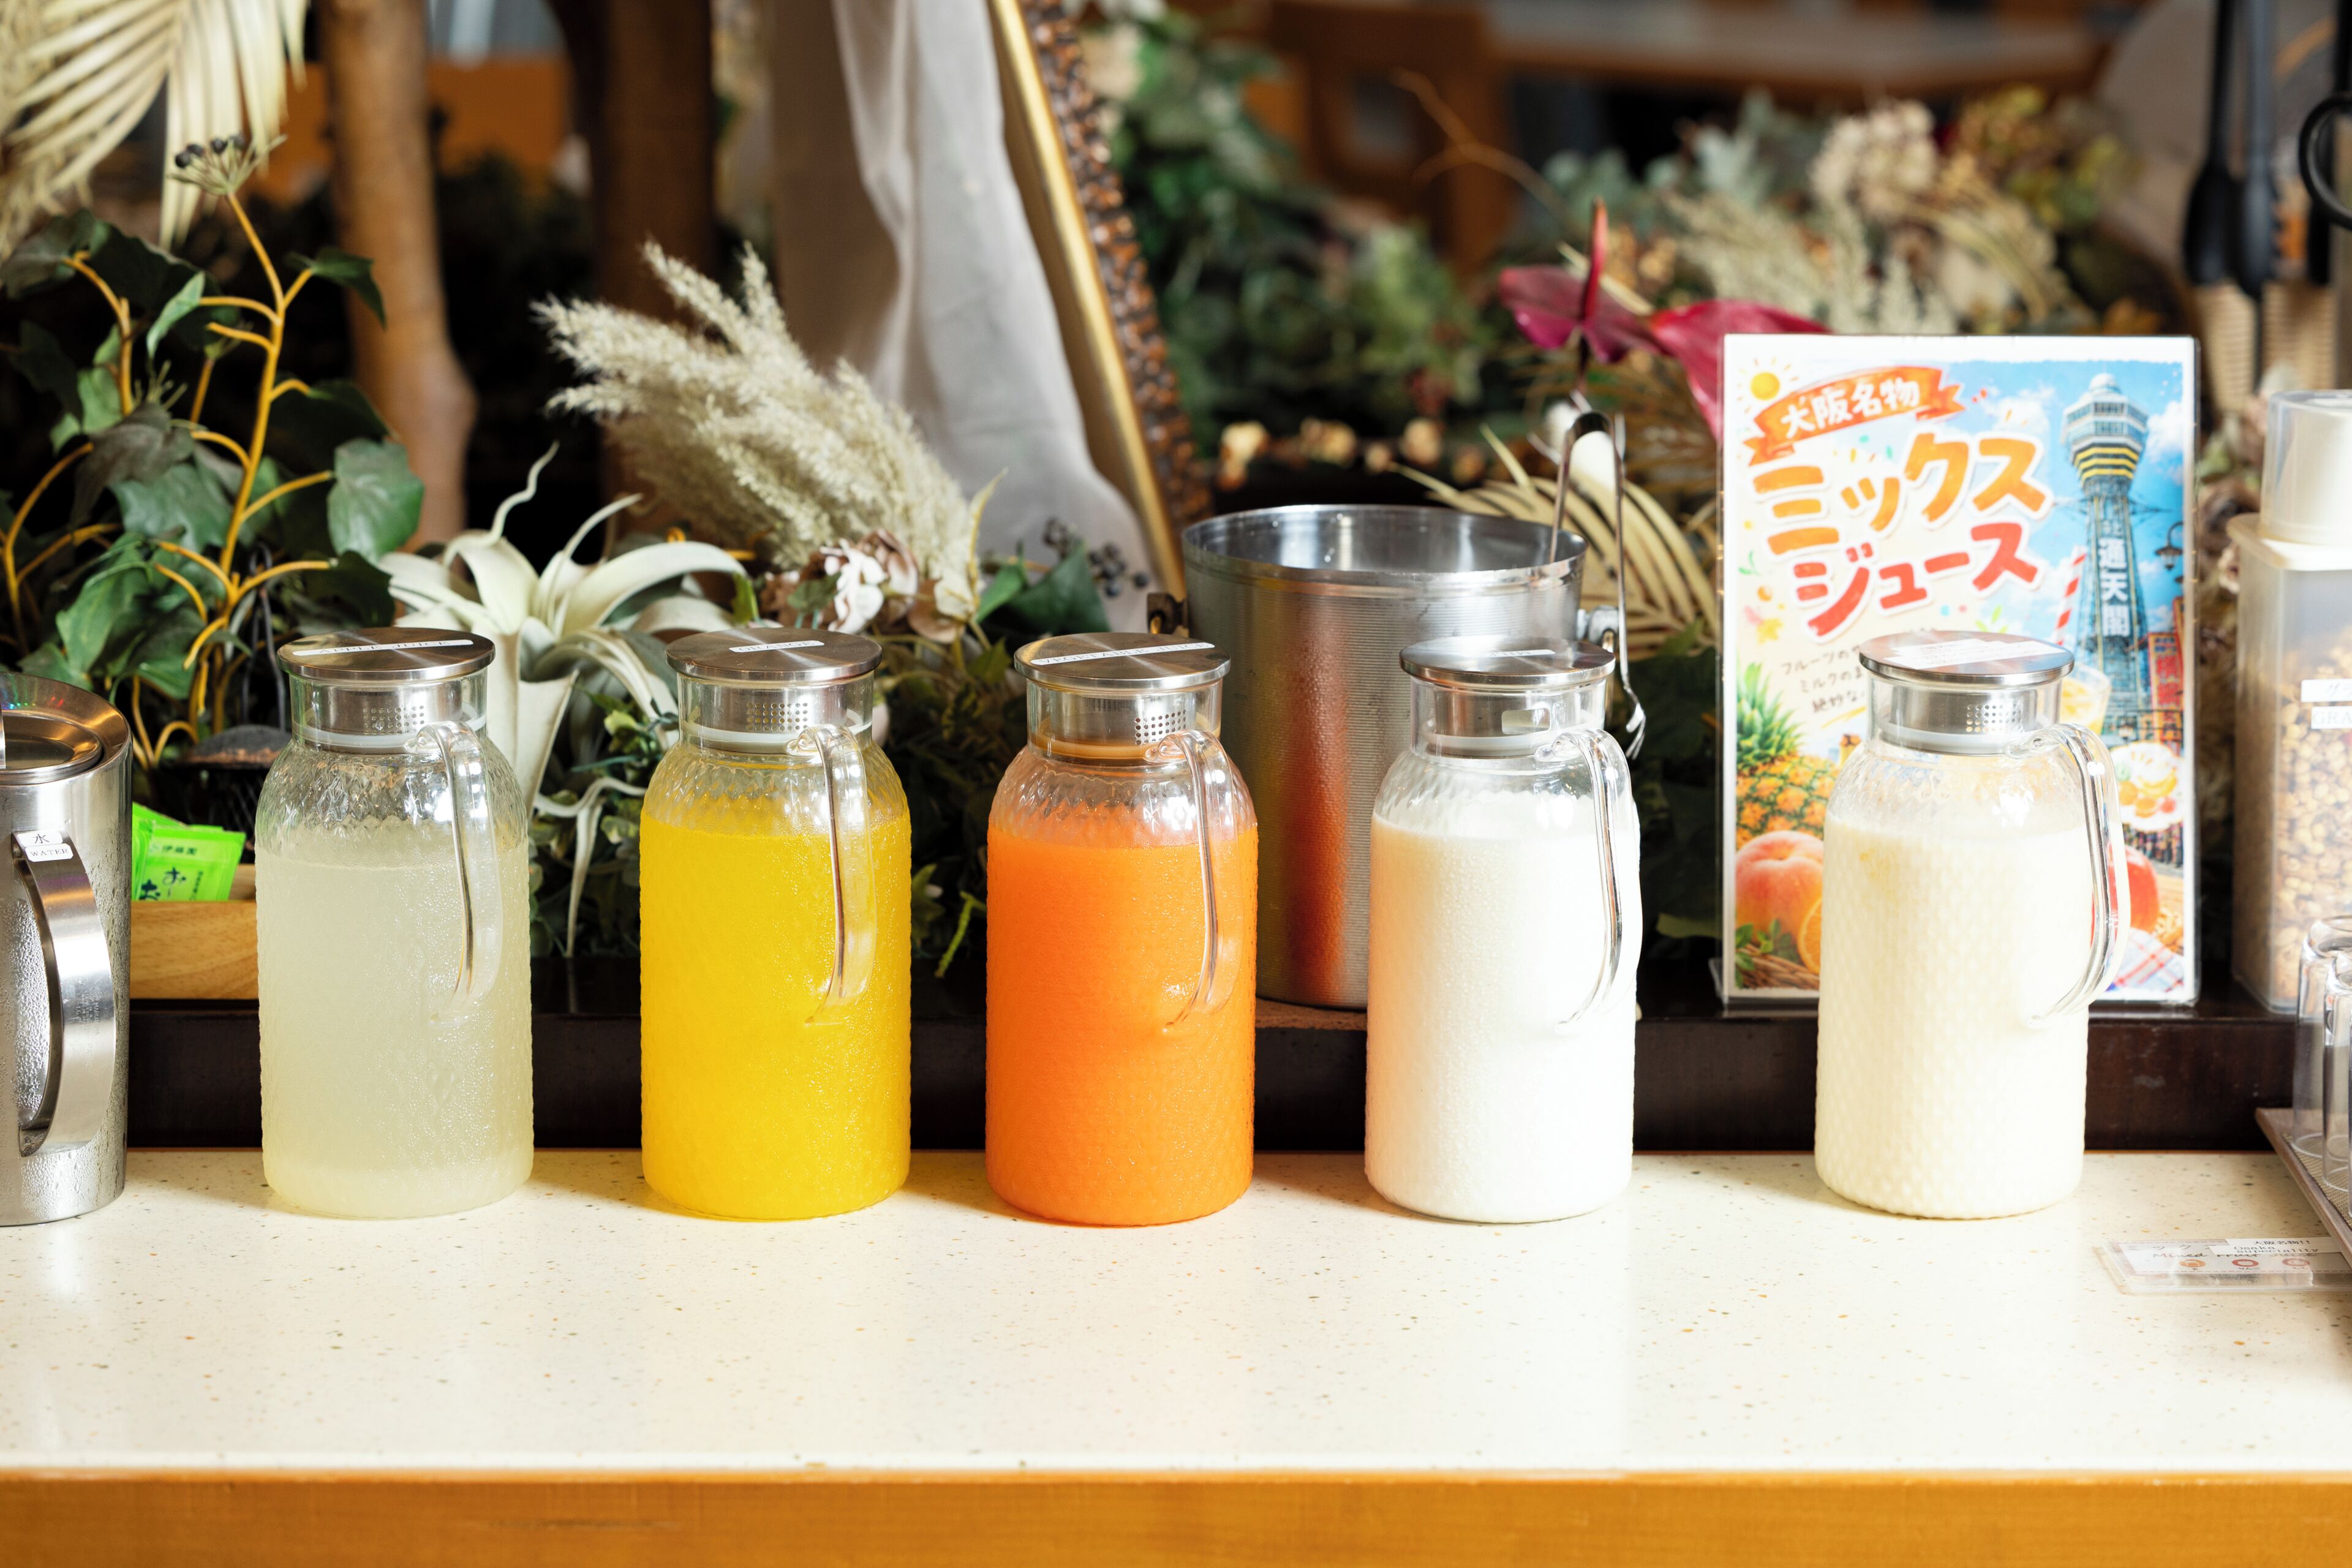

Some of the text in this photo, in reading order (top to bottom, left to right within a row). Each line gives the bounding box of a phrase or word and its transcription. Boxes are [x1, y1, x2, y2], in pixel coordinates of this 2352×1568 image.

[1781, 376, 1921, 439] 大阪名物
[1752, 432, 2047, 556] ミックス
[1792, 521, 2038, 638] ジュース
[319, 645, 382, 654] APPLE
[739, 641, 815, 652] ORANGE
[1039, 643, 1212, 663] VEGETABLE JUICE
[33, 834, 50, 844] 水
[30, 848, 69, 857] WATER
